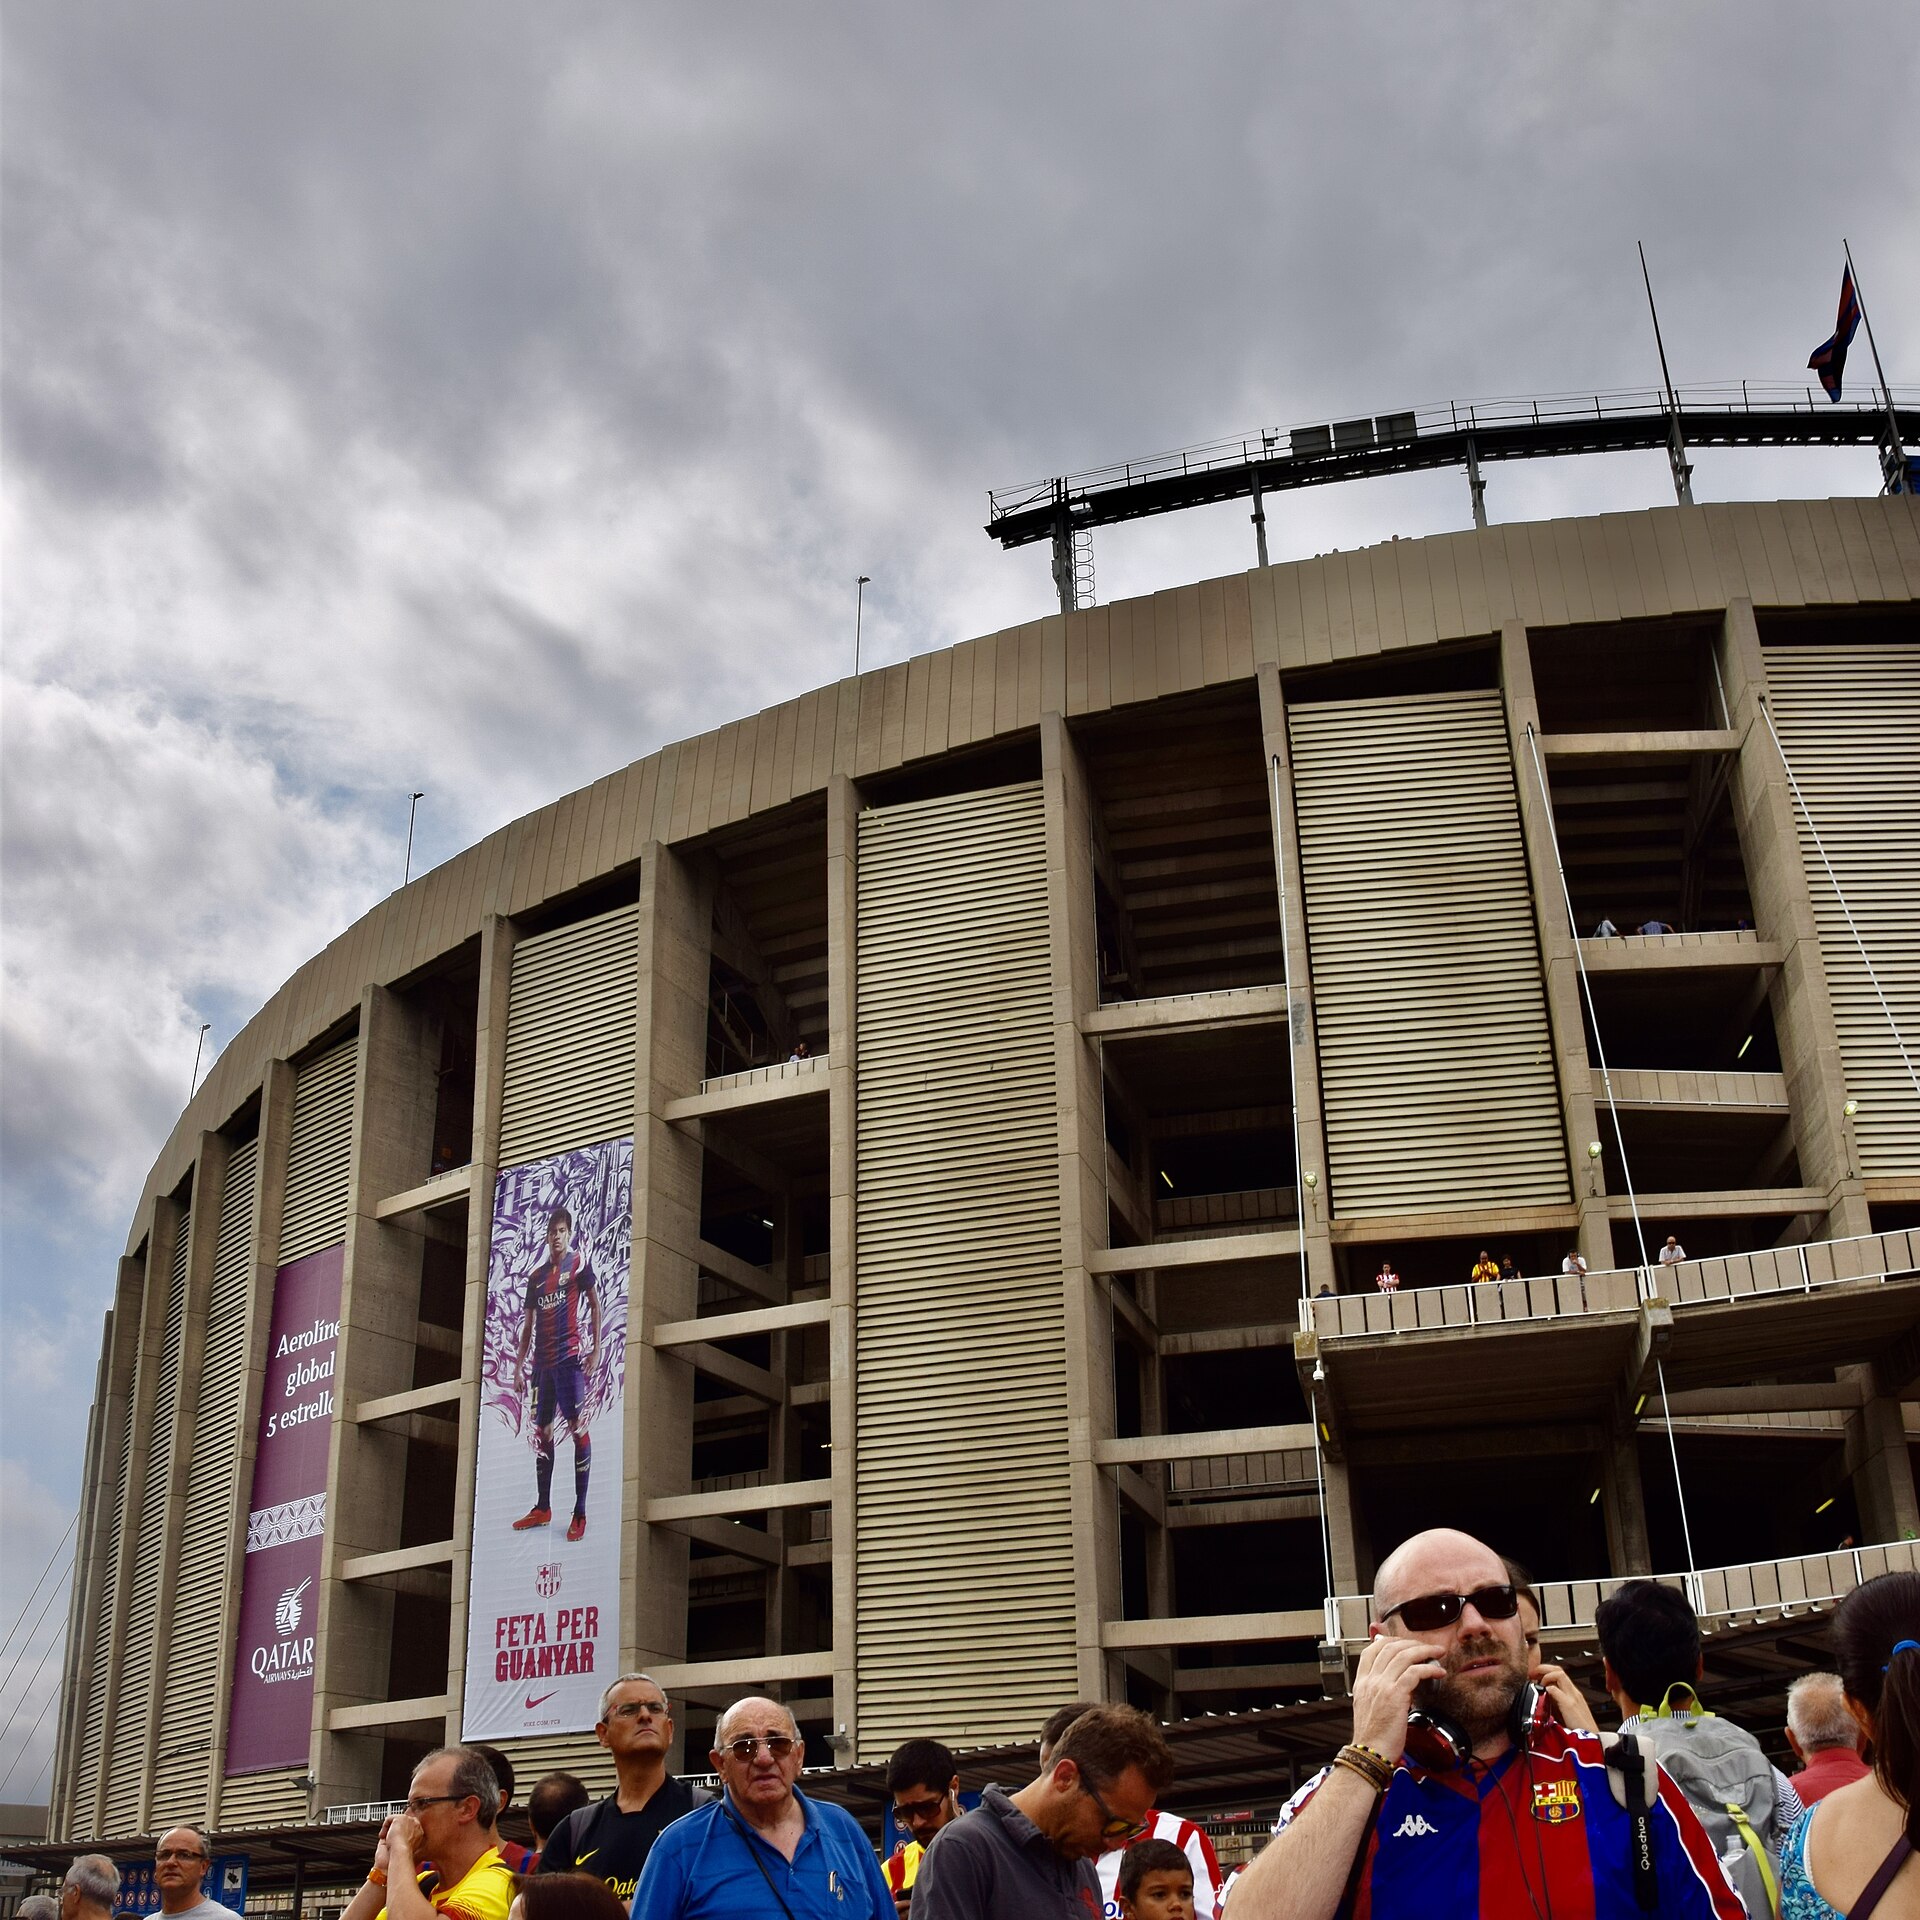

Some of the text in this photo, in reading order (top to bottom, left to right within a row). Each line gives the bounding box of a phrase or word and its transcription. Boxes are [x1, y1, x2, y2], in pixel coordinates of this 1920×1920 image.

[537, 1289, 567, 1307] QATAR
[285, 1350, 336, 1397] global
[266, 1412, 278, 1438] 5
[495, 1605, 599, 1649] FETA PER
[251, 1636, 314, 1679] QATAR
[263, 1669, 292, 1684] AIRWAYS
[495, 1641, 595, 1683] GUANYAR
[1637, 1816, 1651, 1871] Quechua
